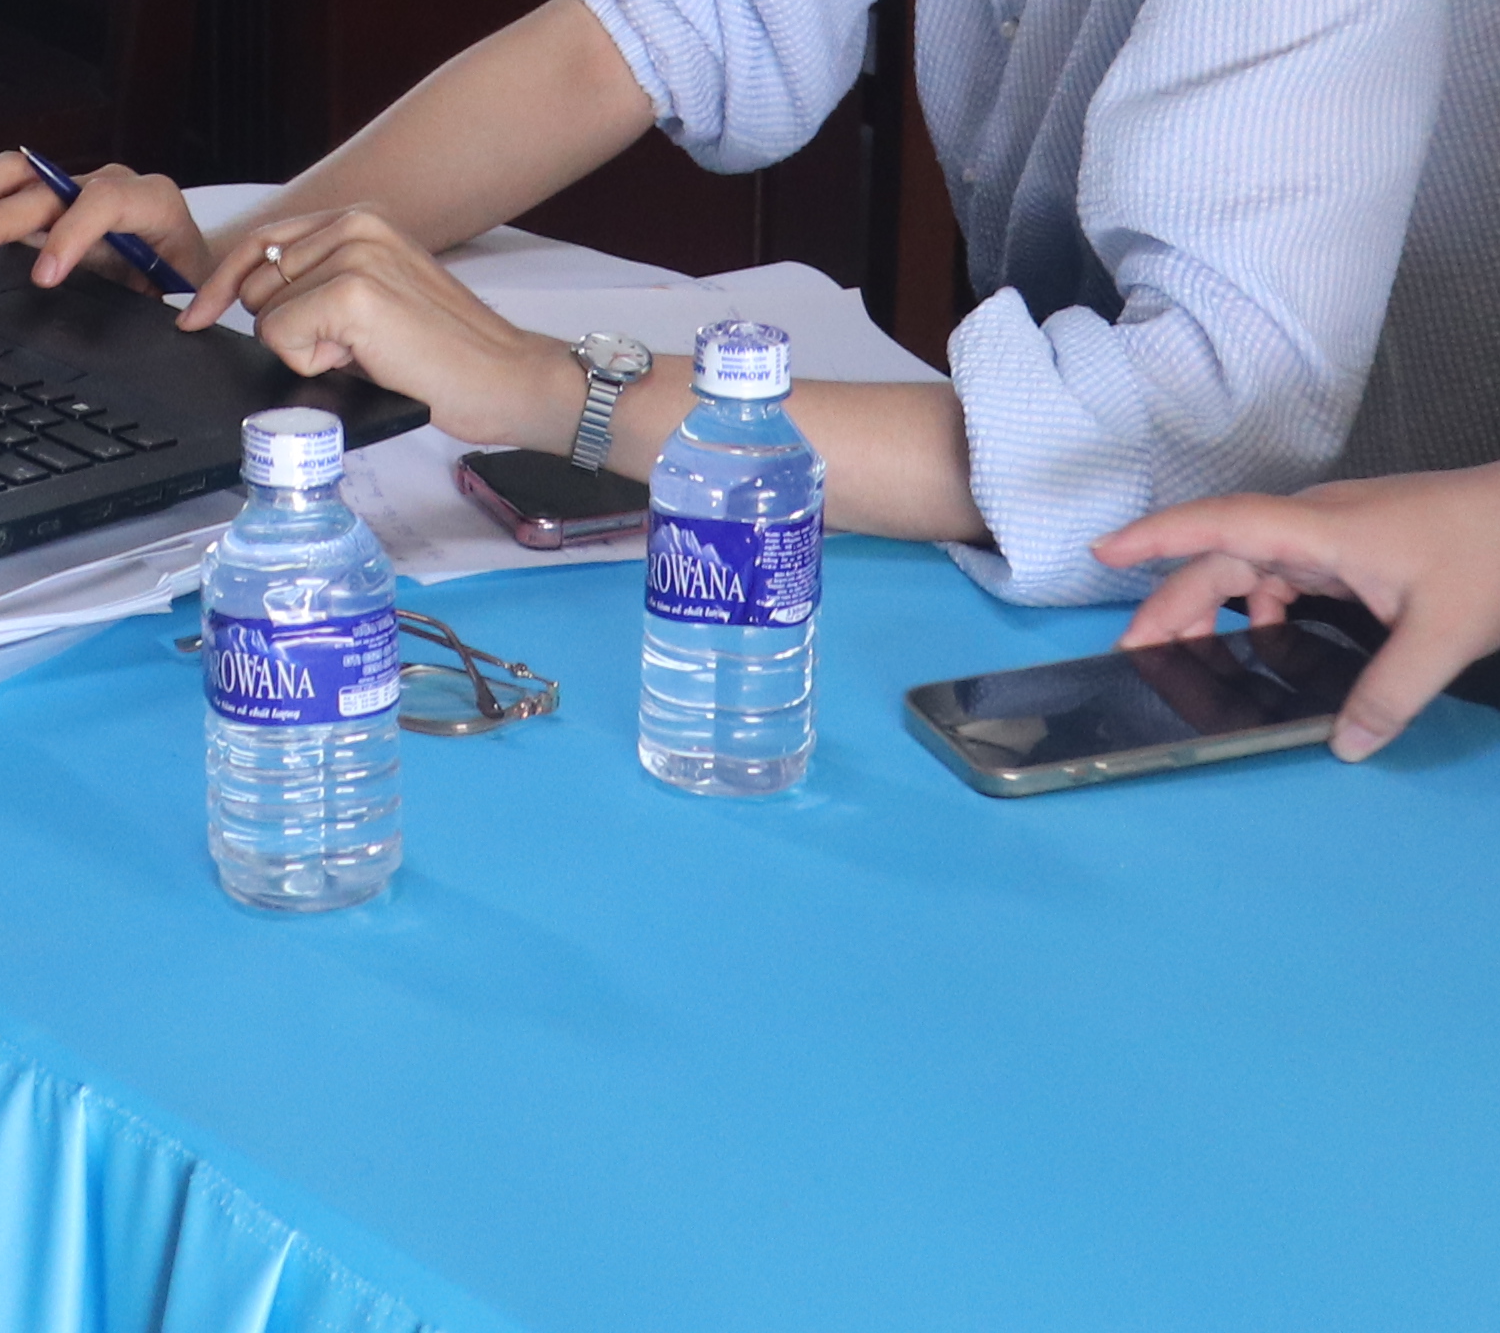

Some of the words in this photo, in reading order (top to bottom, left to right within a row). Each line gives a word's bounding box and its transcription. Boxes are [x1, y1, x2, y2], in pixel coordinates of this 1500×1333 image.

[716, 370, 771, 381] AROWANA
[649, 552, 746, 603] ROWANA
[209, 650, 315, 700] ROWANA
